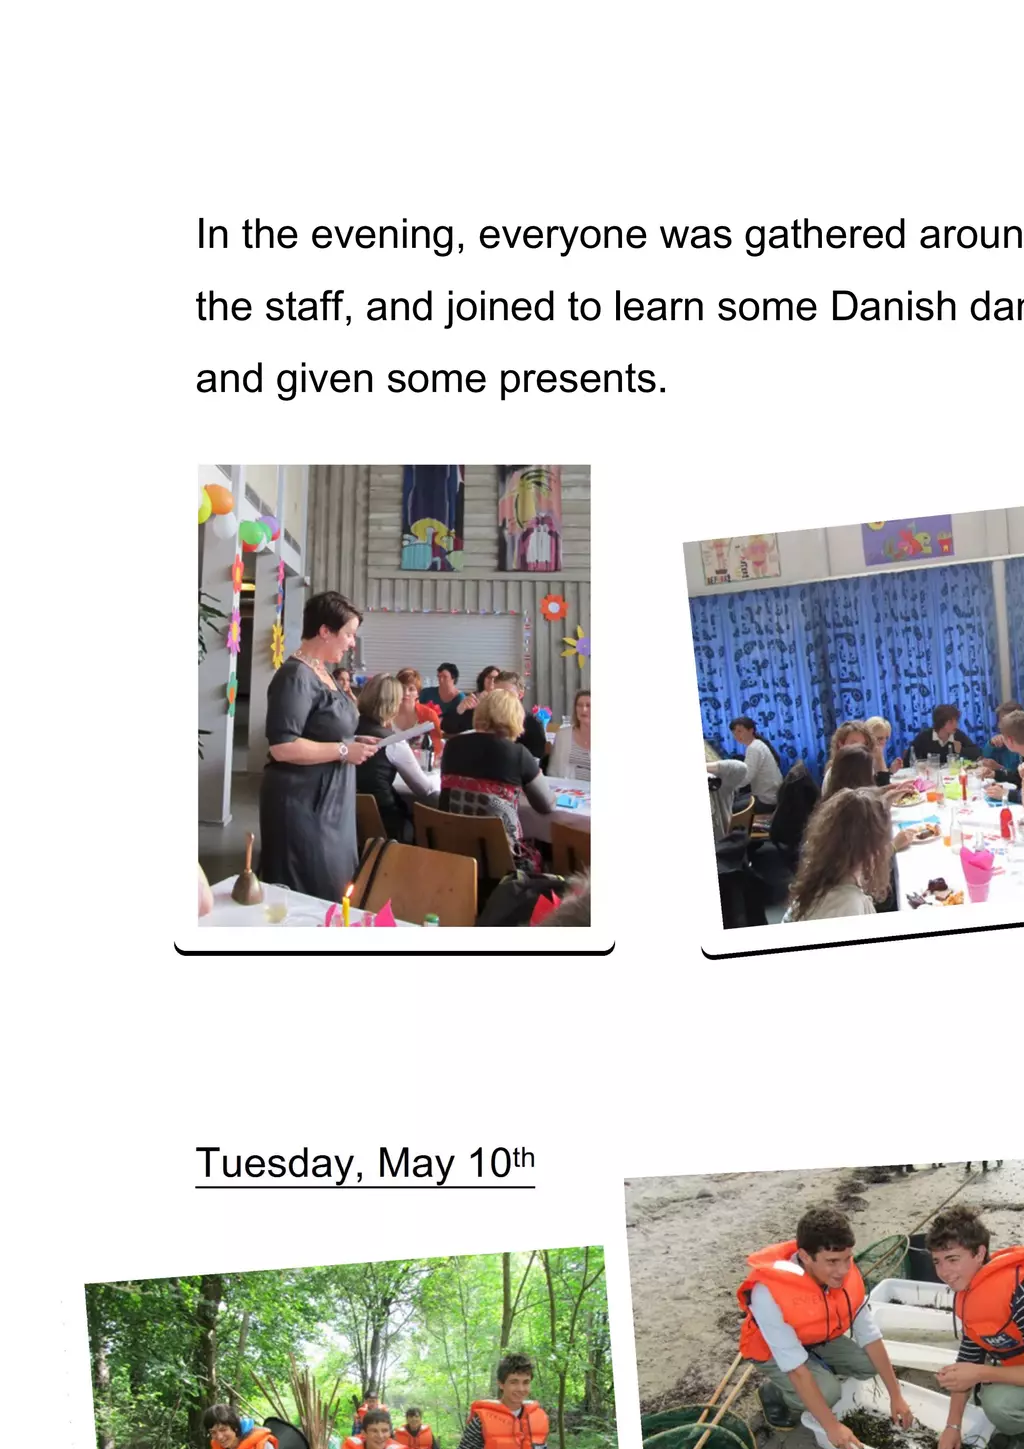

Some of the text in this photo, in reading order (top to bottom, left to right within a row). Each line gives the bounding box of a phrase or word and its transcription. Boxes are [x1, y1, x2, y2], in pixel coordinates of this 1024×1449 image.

[199, 218, 227, 248] In
[242, 218, 297, 249] the
[312, 218, 463, 257] evening,
[480, 226, 646, 257] everyone
[660, 226, 732, 249] was
[745, 218, 904, 257] gathered
[196, 290, 252, 321] the
[266, 290, 351, 326] staff,
[367, 290, 432, 321] and
[444, 290, 553, 329] joined
[568, 292, 601, 321] to
[616, 290, 703, 321] learn
[718, 298, 817, 321] some
[833, 290, 955, 321] Danish
[197, 362, 665, 401] and given some presents.
[196, 1147, 535, 1186] Tuesday, May 10th
